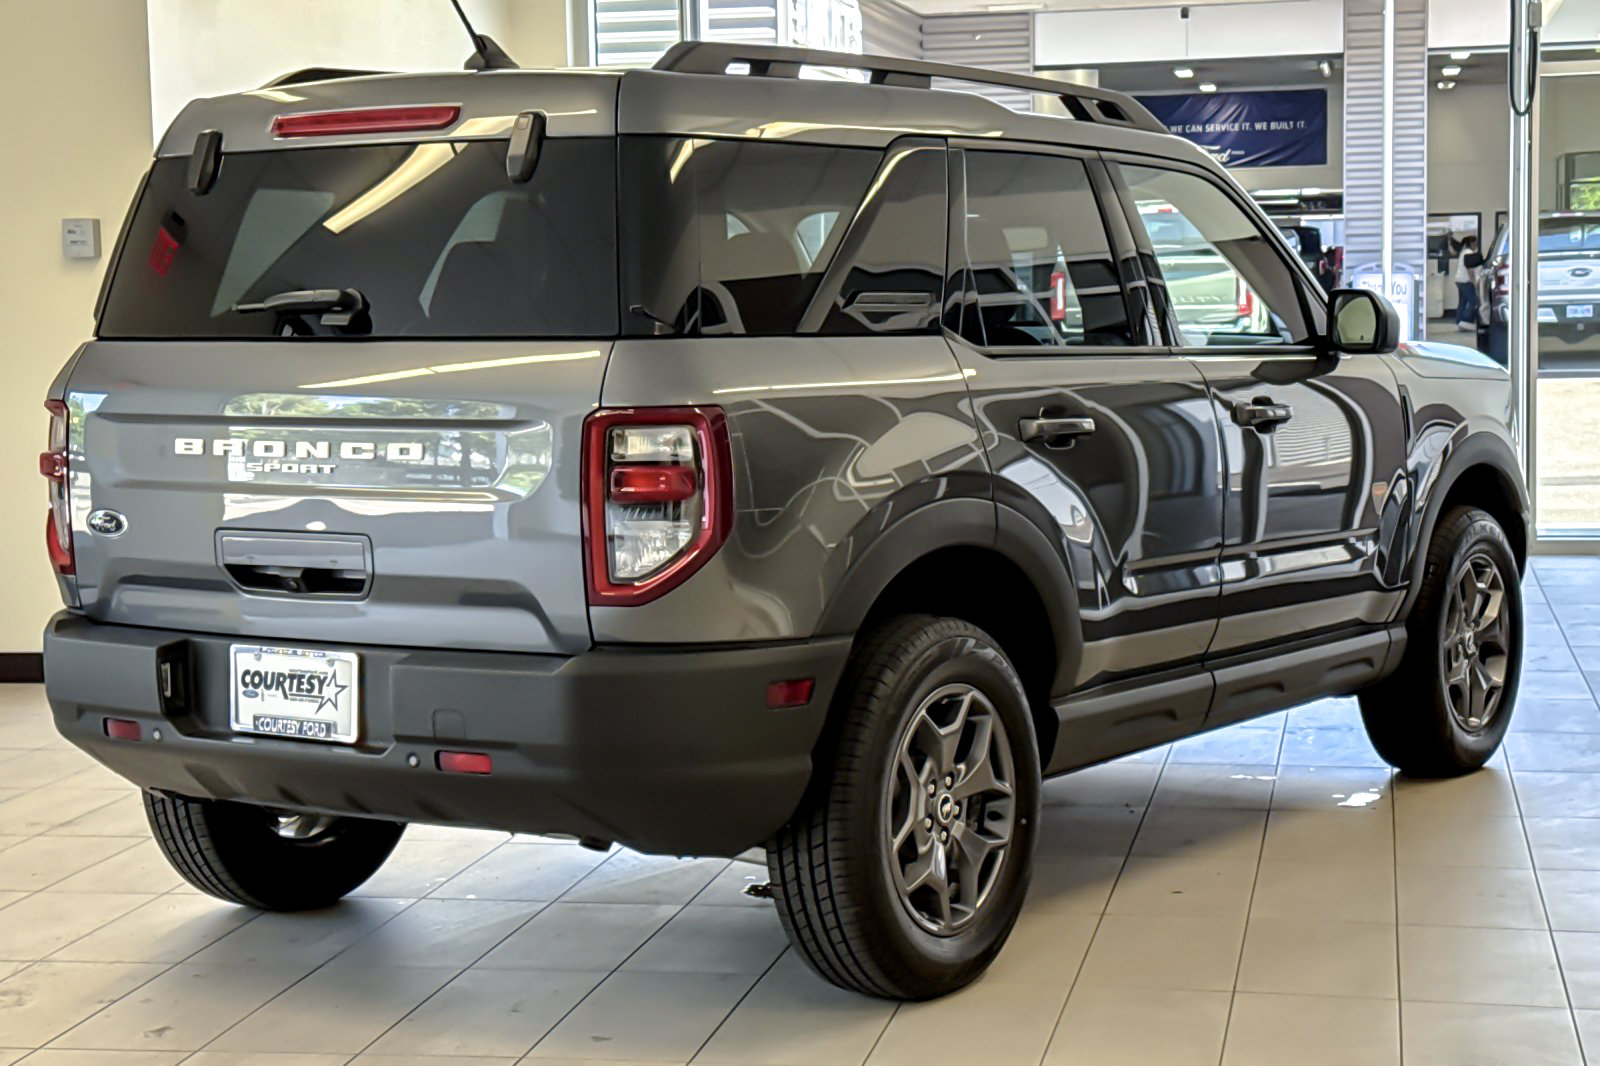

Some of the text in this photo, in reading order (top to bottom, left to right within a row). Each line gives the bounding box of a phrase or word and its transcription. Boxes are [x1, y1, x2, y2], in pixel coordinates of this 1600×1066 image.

[1169, 121, 1308, 133] WE CAN SERVICE IT. WE BUILT IT.
[174, 437, 425, 461] BRONCO
[246, 462, 337, 475] SPORT
[241, 669, 329, 700] COURTESY
[258, 717, 327, 737] COURTESY FORD
